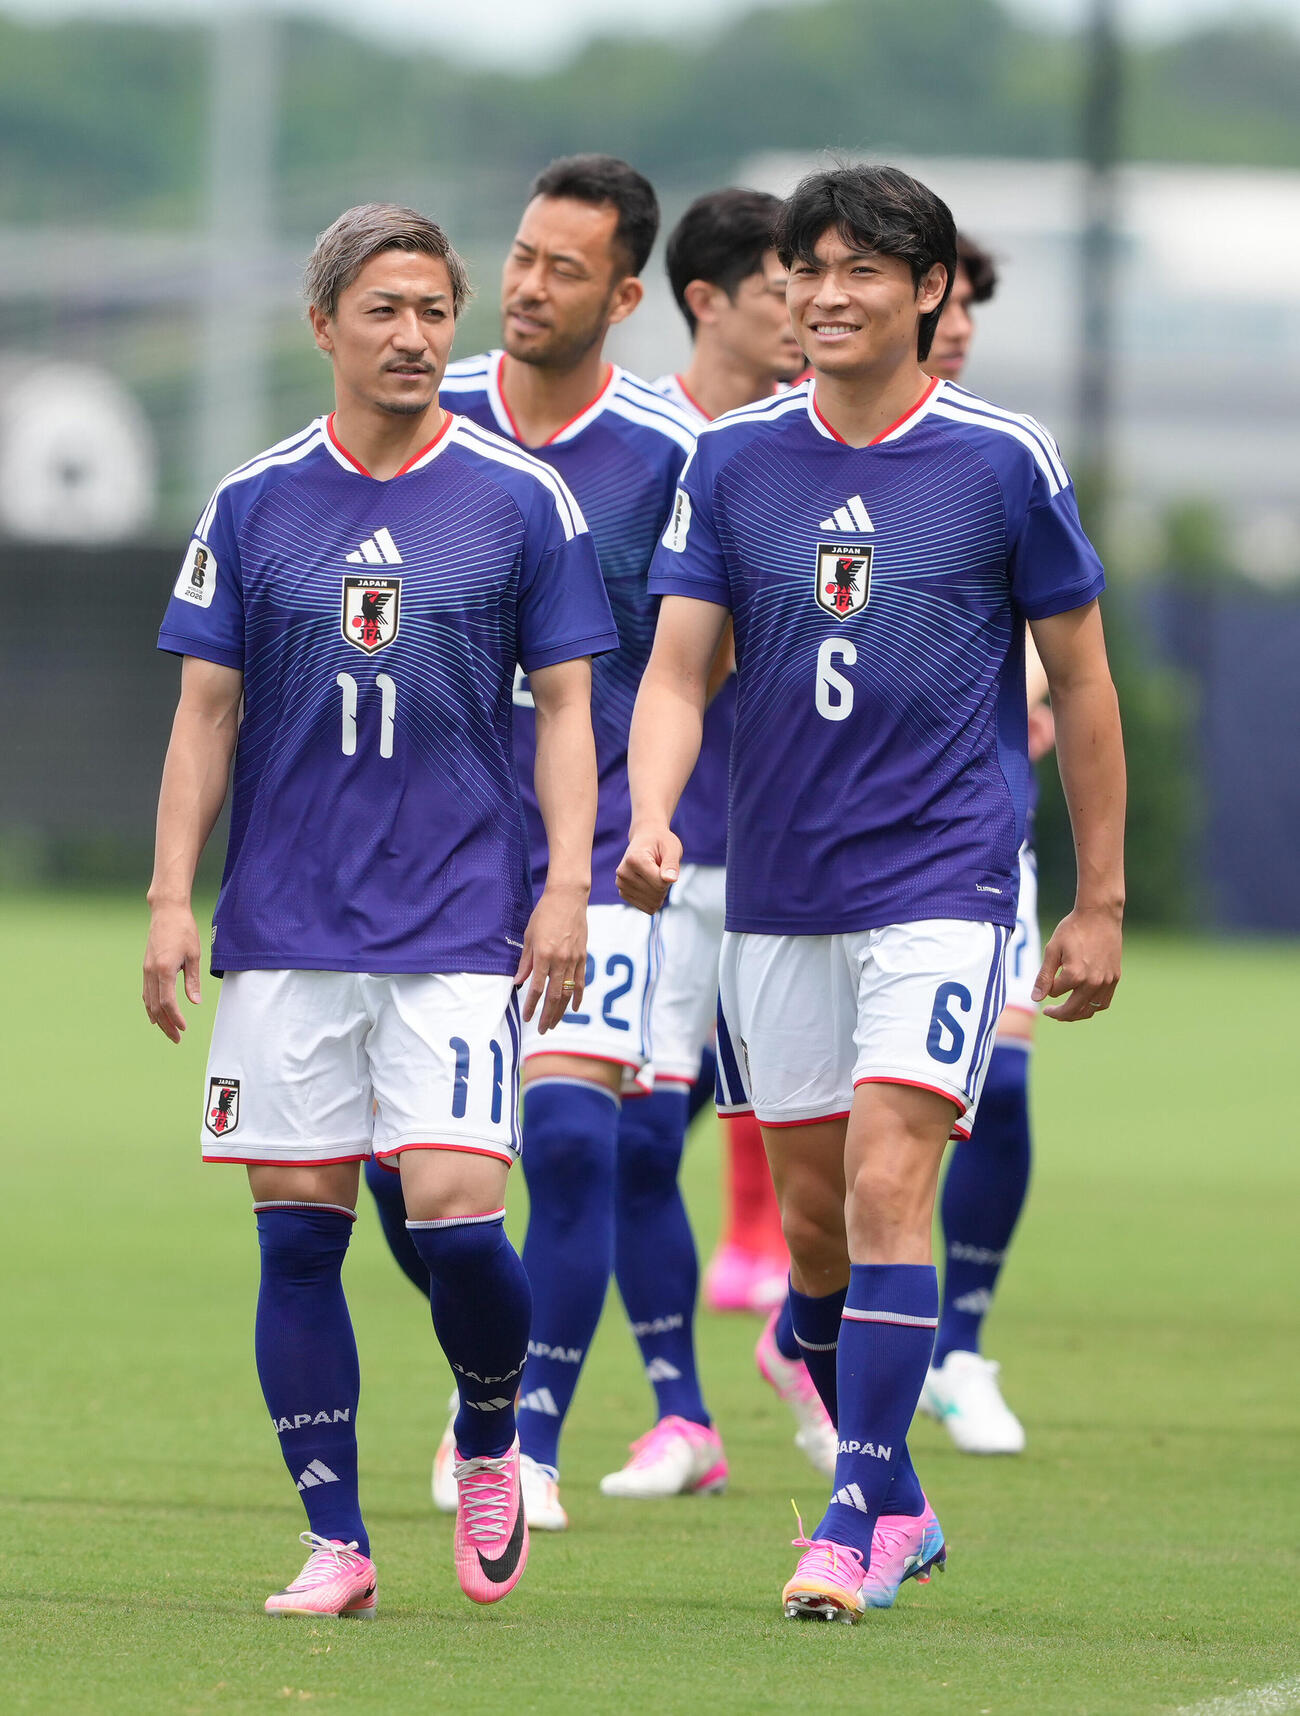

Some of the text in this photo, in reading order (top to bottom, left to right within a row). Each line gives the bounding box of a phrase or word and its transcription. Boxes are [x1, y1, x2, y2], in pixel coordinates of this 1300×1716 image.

[831, 546, 861, 555] JAPAN
[357, 579, 388, 588] JAPAN
[830, 595, 854, 608] JFA
[357, 628, 383, 641] JFA
[815, 637, 858, 722] 6
[336, 672, 397, 759] 11
[926, 981, 972, 1065] 6
[449, 1035, 504, 1125] 11
[211, 1118, 229, 1129] JFA
